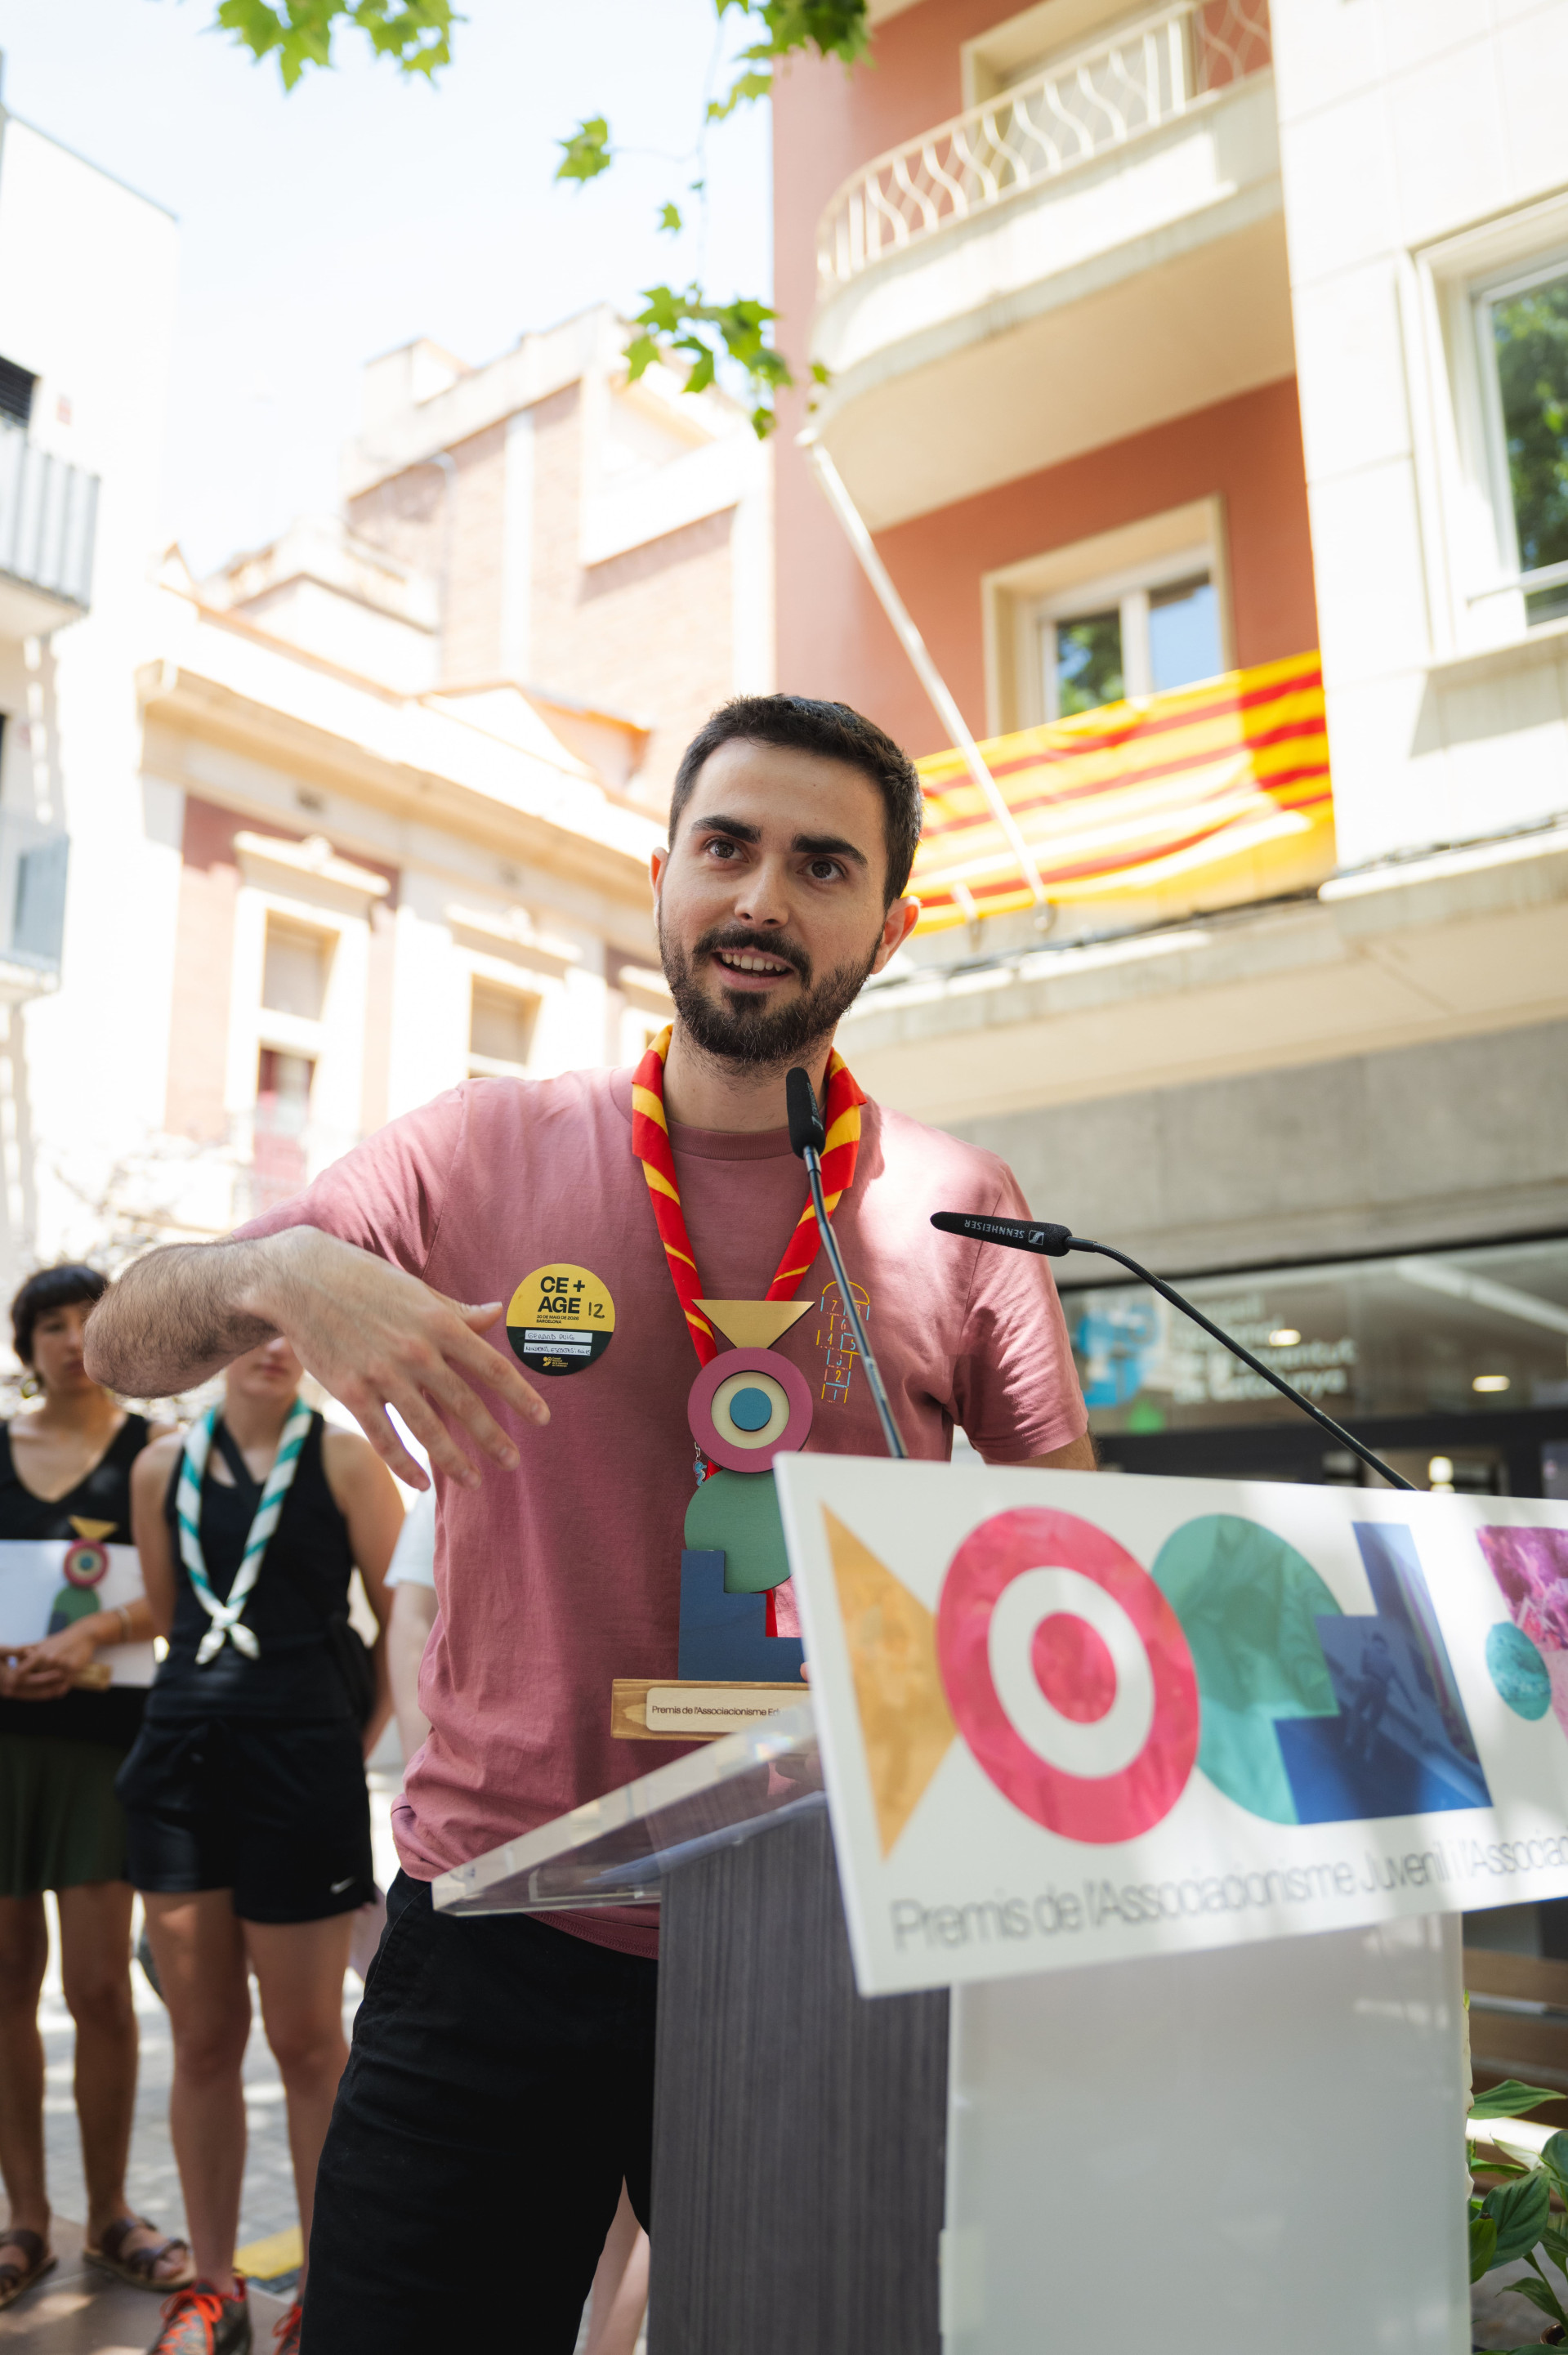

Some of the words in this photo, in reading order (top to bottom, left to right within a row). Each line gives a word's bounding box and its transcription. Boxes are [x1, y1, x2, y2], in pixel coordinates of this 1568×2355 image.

[964, 1218, 1025, 1239] SENNHEISER
[540, 1276, 570, 1293] CE
[538, 1296, 581, 1314] AGE
[588, 1302, 605, 1319] 12
[832, 1299, 838, 1312] 7
[527, 1332, 556, 1340] GERARD
[835, 1370, 842, 1383] 2
[651, 1705, 681, 1714] Premis
[681, 1705, 693, 1714] de
[694, 1705, 767, 1717] l'Associacionisme
[889, 1887, 1031, 1953] Premis
[1032, 1879, 1083, 1936] de
[1360, 1839, 1450, 1892] Juvenil
[1459, 1824, 1568, 1881] l'Associac
